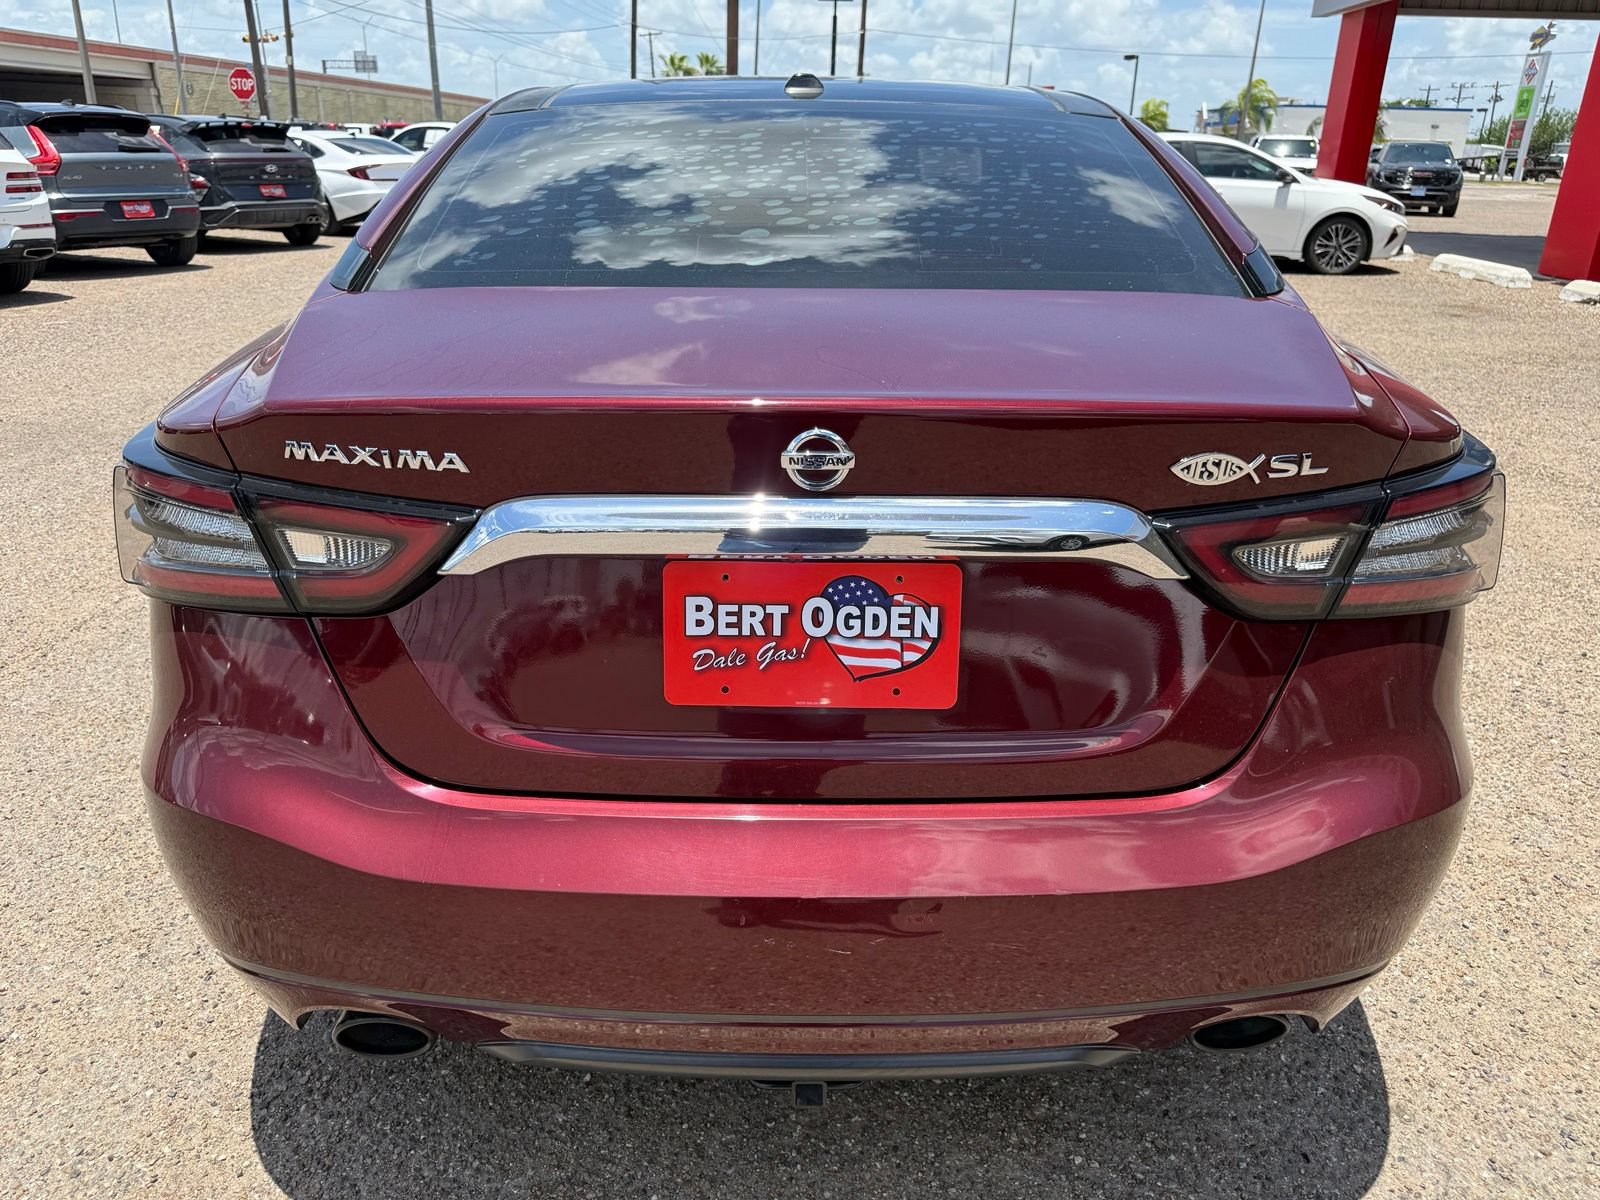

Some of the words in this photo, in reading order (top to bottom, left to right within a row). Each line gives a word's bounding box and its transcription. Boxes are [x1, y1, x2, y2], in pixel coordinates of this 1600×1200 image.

[230, 77, 254, 91] STOP
[284, 440, 470, 473] MAXIMA
[788, 456, 849, 468] NISSAN
[1182, 457, 1242, 482] JESUS
[1267, 452, 1329, 478] SL
[684, 595, 790, 638] BERT
[801, 596, 940, 639] OGDEN
[692, 648, 747, 672] Dale
[756, 638, 810, 671] Gas!
